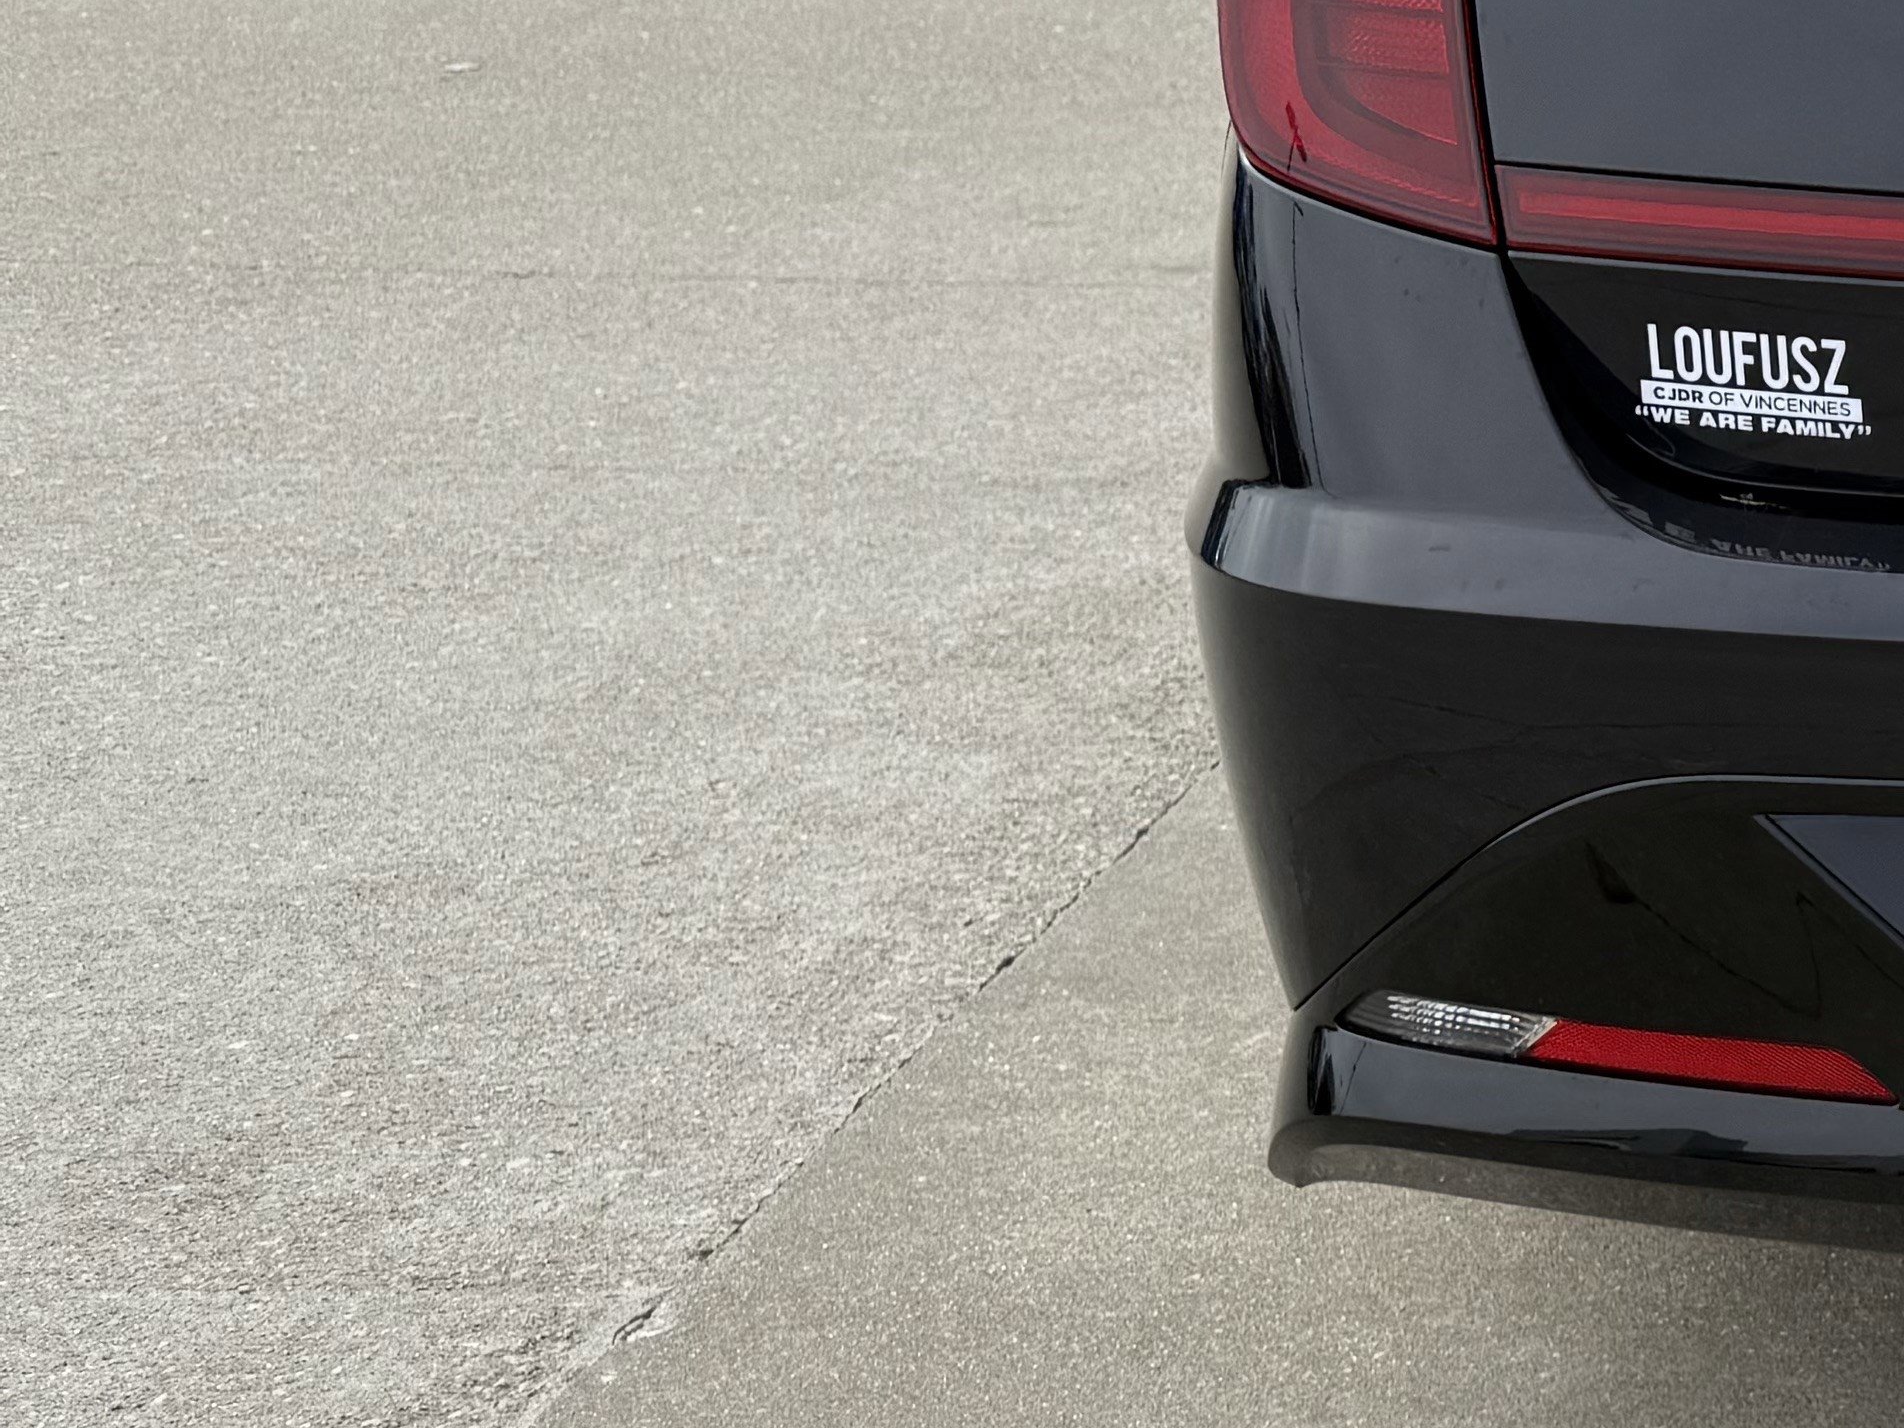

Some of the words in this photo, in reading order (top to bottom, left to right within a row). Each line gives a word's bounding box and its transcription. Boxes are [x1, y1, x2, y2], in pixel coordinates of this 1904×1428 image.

[1653, 385, 1704, 404] CJDR
[1708, 391, 1735, 407] OF
[1740, 393, 1851, 418] VINCENNES
[1700, 412, 1753, 432] ARE
